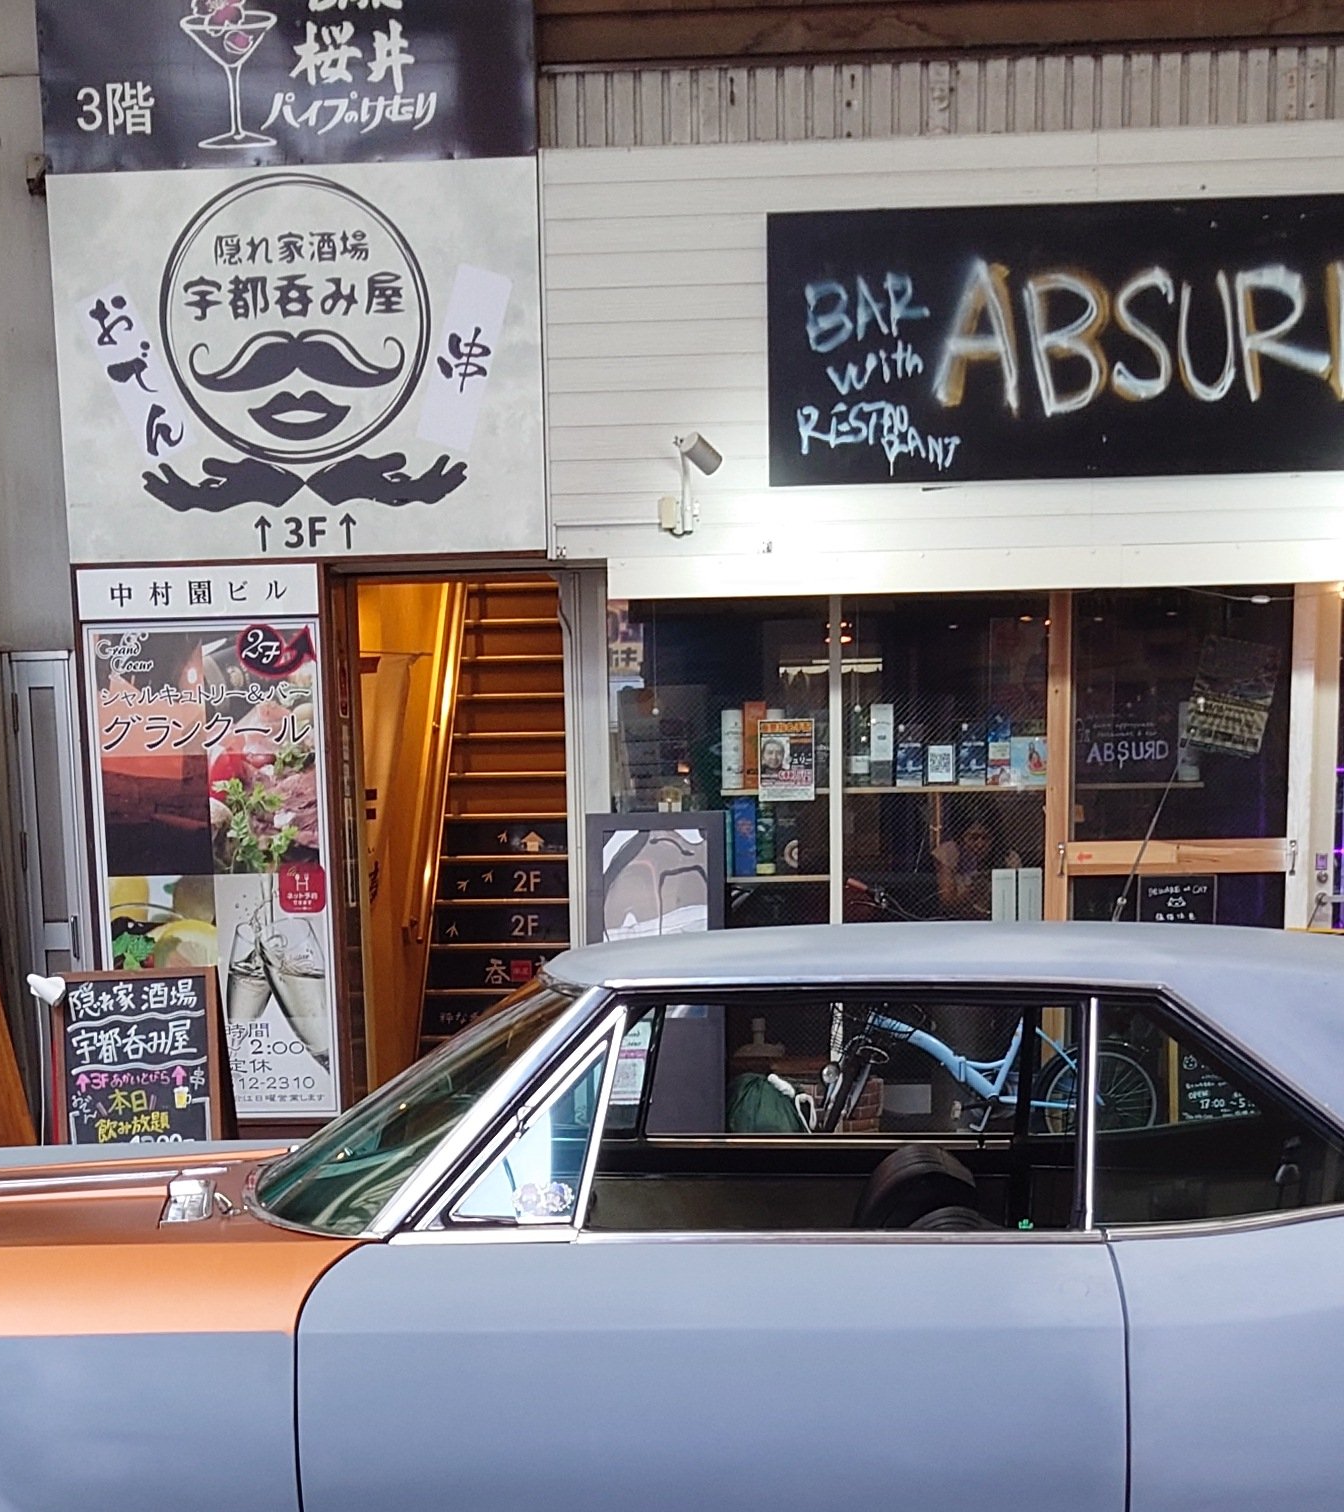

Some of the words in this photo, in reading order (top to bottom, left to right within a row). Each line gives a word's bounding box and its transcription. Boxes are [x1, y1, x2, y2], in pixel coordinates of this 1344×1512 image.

[289, 18, 415, 93] 桜井
[76, 81, 155, 136] 3階
[260, 90, 438, 135] パイプのけむり
[213, 229, 370, 266] 隠れ家酒場
[182, 272, 405, 321] 宇都呑み屋
[805, 271, 930, 353] BAR
[88, 295, 185, 457] おでん
[437, 327, 492, 393] 串
[825, 339, 924, 396] with
[284, 516, 328, 549] 3F
[109, 579, 289, 607] 中村園ビル
[241, 628, 282, 664] 2F
[101, 683, 311, 708] シャルキュトリー&バー
[103, 714, 312, 751] グランクール
[513, 870, 541, 893] 2F
[510, 914, 539, 937] 2F
[71, 1019, 198, 1064] 宇都呑み屋
[250, 1038, 305, 1056] 2:00
[107, 1088, 149, 1115] 本日
